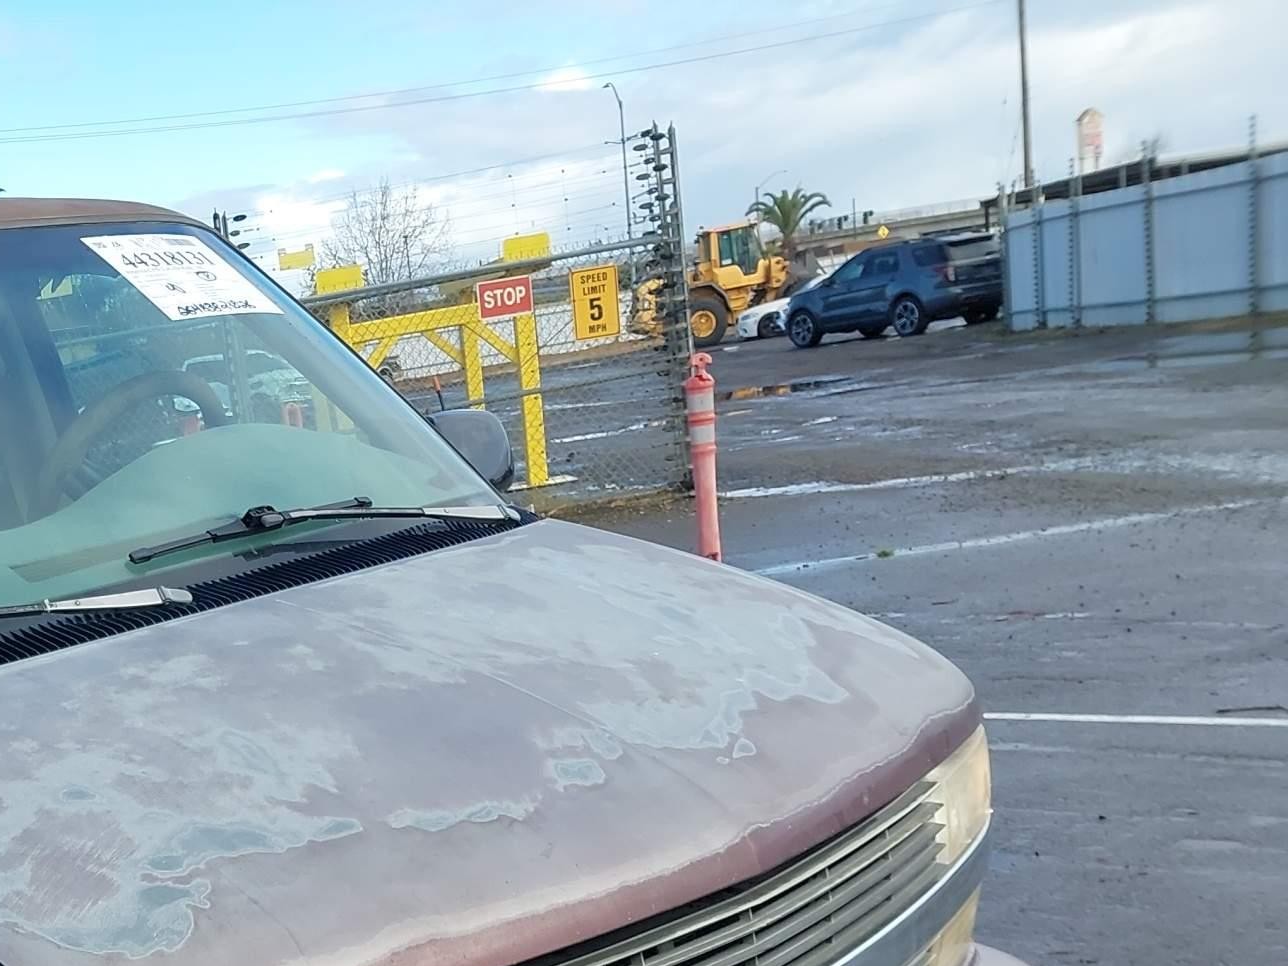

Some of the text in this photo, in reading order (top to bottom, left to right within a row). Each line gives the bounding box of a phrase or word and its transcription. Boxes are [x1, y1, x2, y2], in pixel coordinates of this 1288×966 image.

[120, 251, 216, 268] 44318131
[580, 272, 608, 285] SPEED
[483, 286, 526, 309] STOP
[582, 284, 606, 296] LIMIT
[589, 297, 604, 321] 5
[588, 324, 607, 334] MPH
